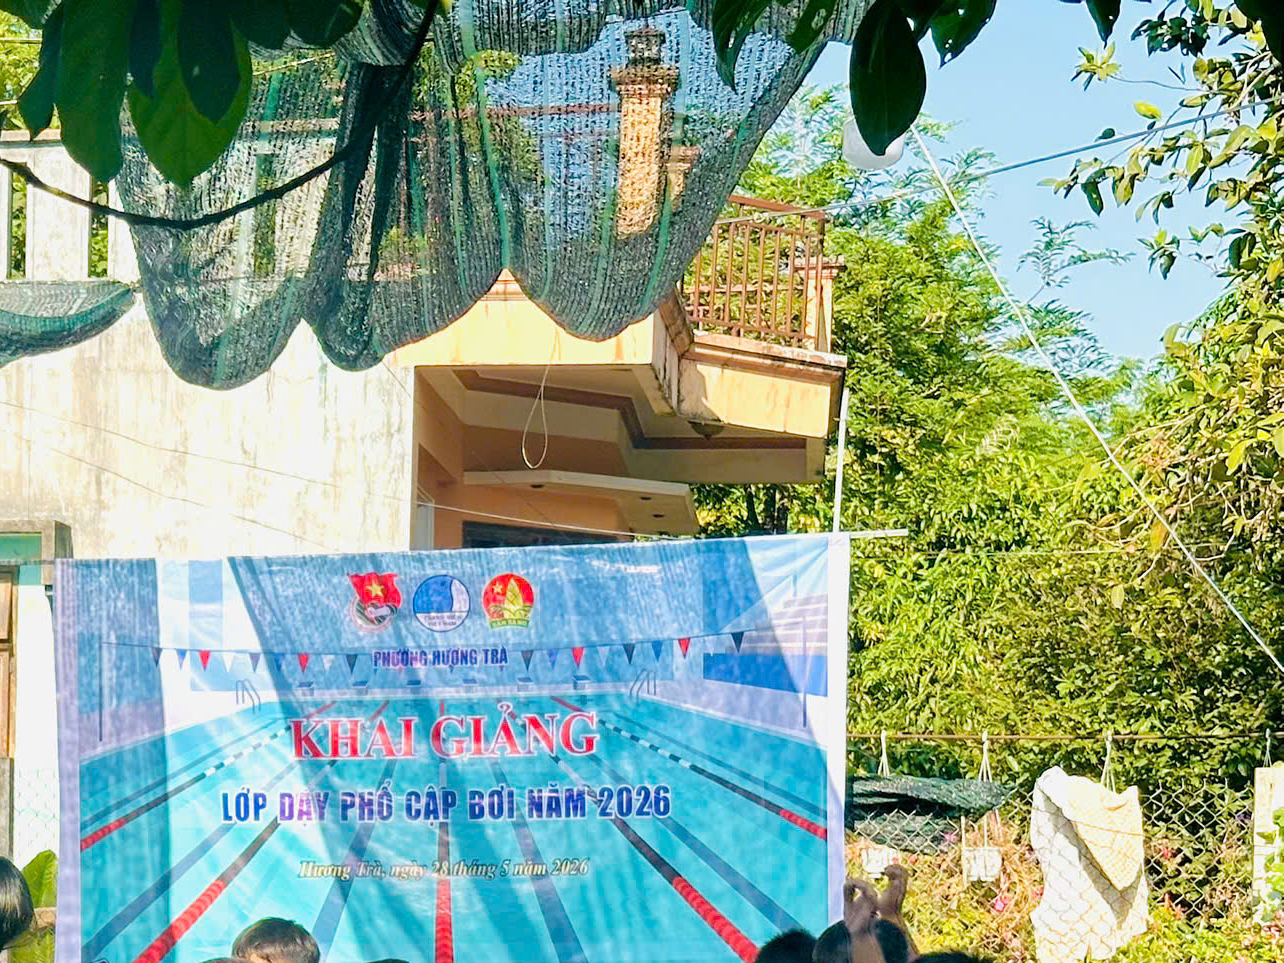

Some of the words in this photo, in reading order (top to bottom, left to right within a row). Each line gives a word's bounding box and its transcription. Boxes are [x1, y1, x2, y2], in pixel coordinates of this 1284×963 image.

[432, 647, 478, 666] HƯƠNG
[482, 645, 508, 664] TRÀ
[430, 702, 598, 757] GIẢNG
[221, 787, 267, 822] LỚP
[278, 790, 330, 827] DẠY
[340, 780, 394, 822] PHỔ
[405, 785, 457, 827] CẬP
[468, 784, 515, 820] BƠI
[527, 783, 587, 819] NĂM
[598, 785, 671, 818] 2026
[298, 860, 352, 881] Hương
[389, 859, 427, 880] ngày
[452, 859, 497, 881] tháng
[500, 859, 511, 877] 5
[513, 857, 548, 876] năm
[551, 858, 590, 877] 2026
